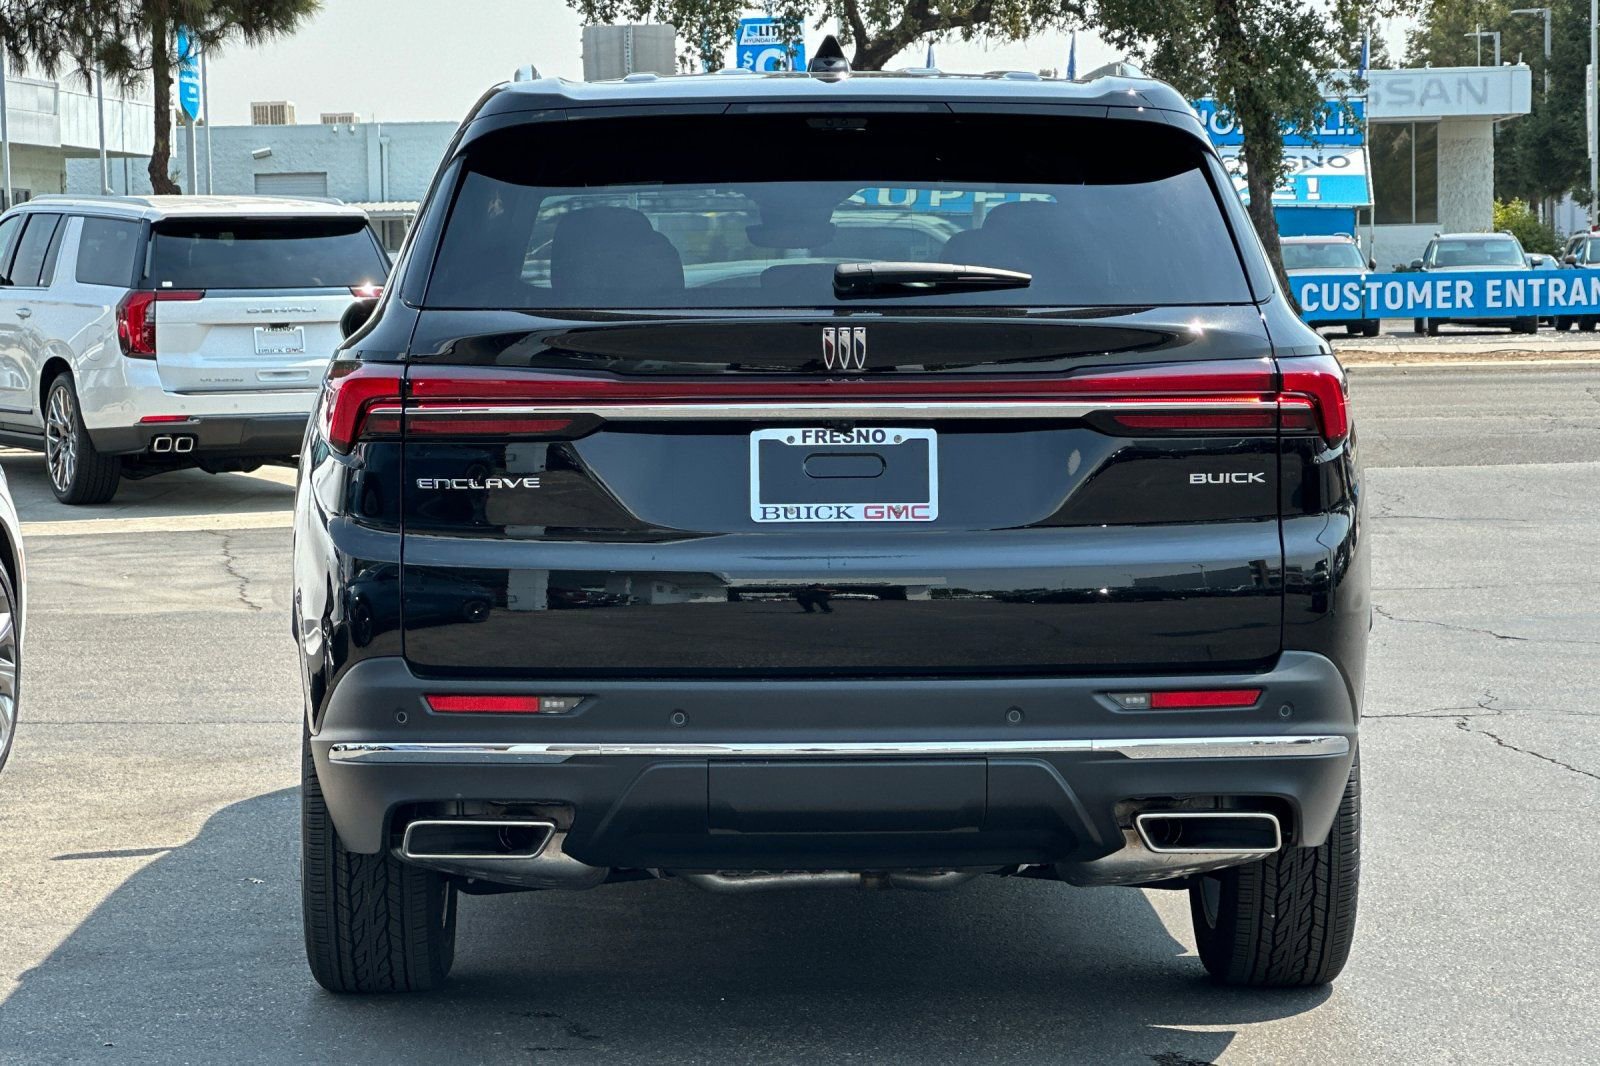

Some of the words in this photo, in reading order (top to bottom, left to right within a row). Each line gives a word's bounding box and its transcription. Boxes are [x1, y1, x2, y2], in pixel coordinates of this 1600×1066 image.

[758, 25, 803, 37] LITHA
[1301, 280, 1474, 312] CUSTOMER
[801, 429, 886, 444] FRESNO
[416, 477, 541, 489] ENCLAVE
[1189, 472, 1266, 484] BUICK
[759, 505, 855, 520] BUICK
[863, 505, 930, 519] GMC
